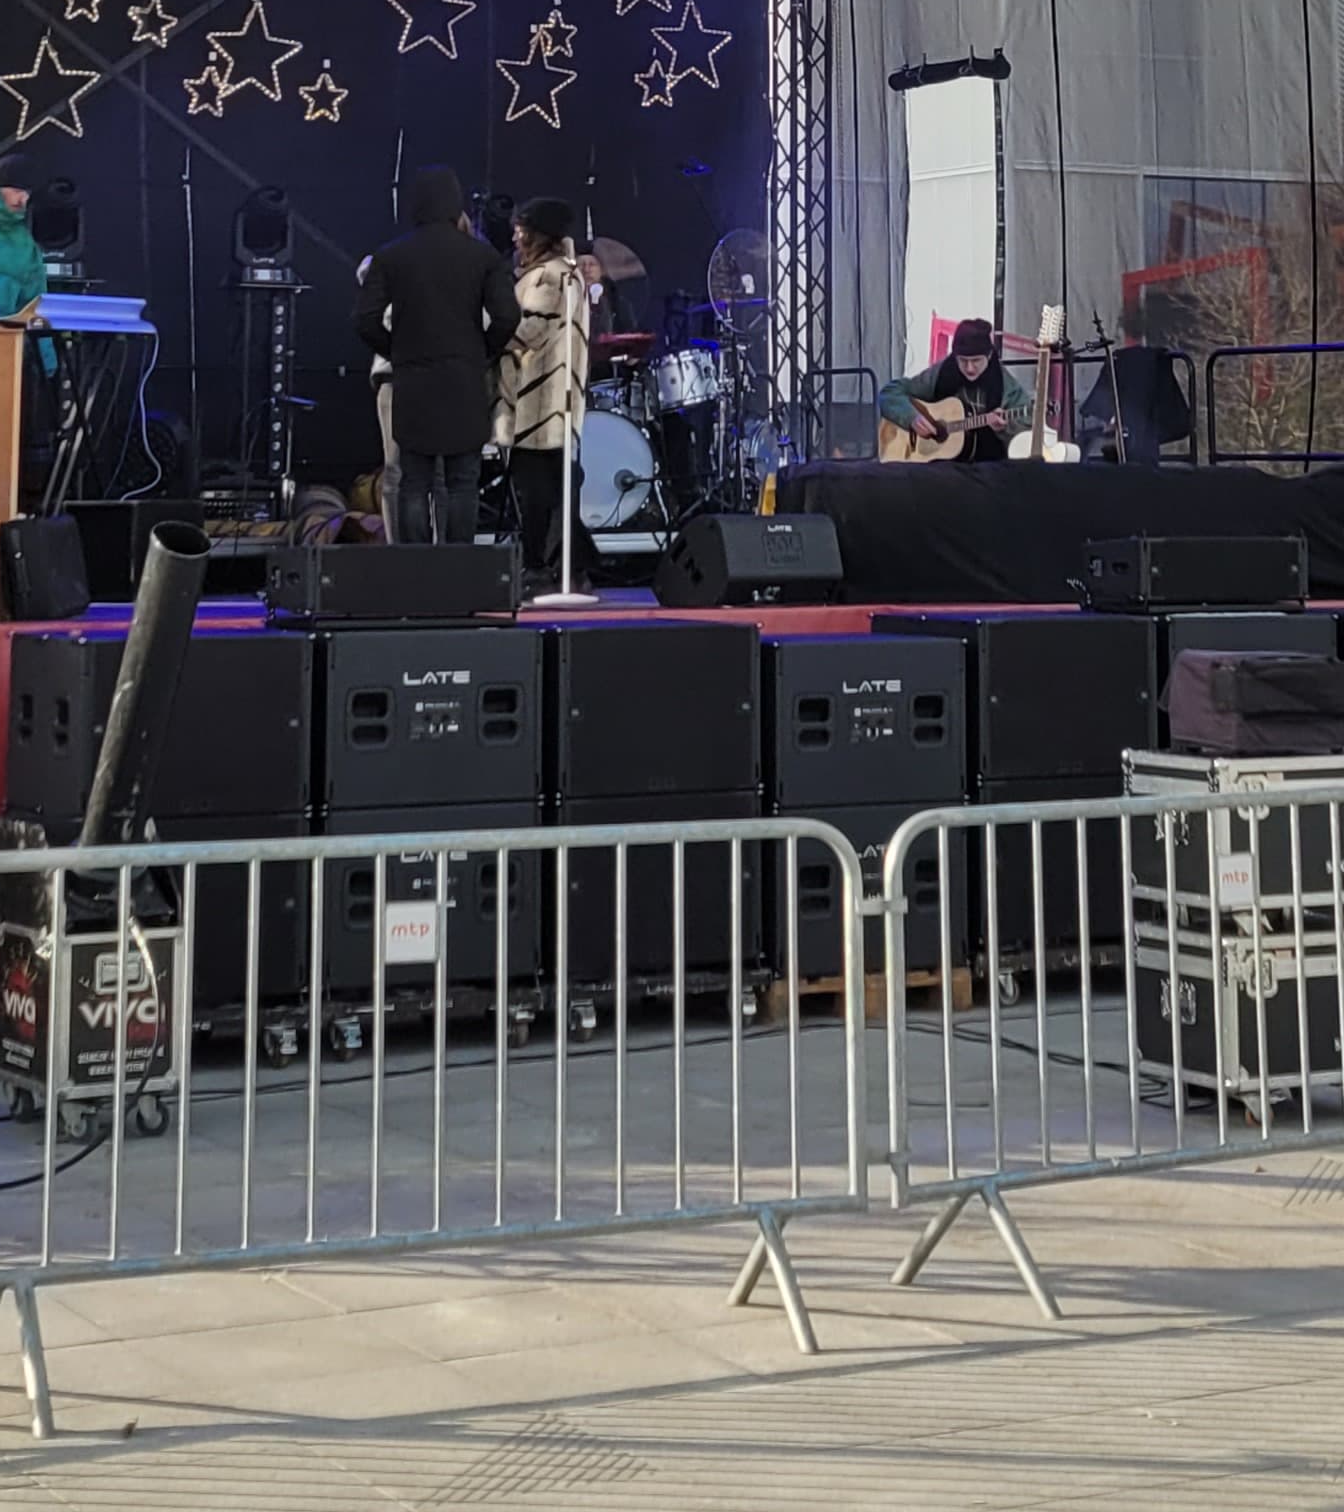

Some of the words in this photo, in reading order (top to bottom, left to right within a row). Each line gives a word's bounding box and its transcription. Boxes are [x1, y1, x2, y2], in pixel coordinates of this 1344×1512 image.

[403, 670, 471, 686] LATE
[842, 679, 902, 694] LATE
[400, 848, 468, 863] LAE
[1222, 869, 1250, 885] mtp
[391, 921, 430, 938] mtp
